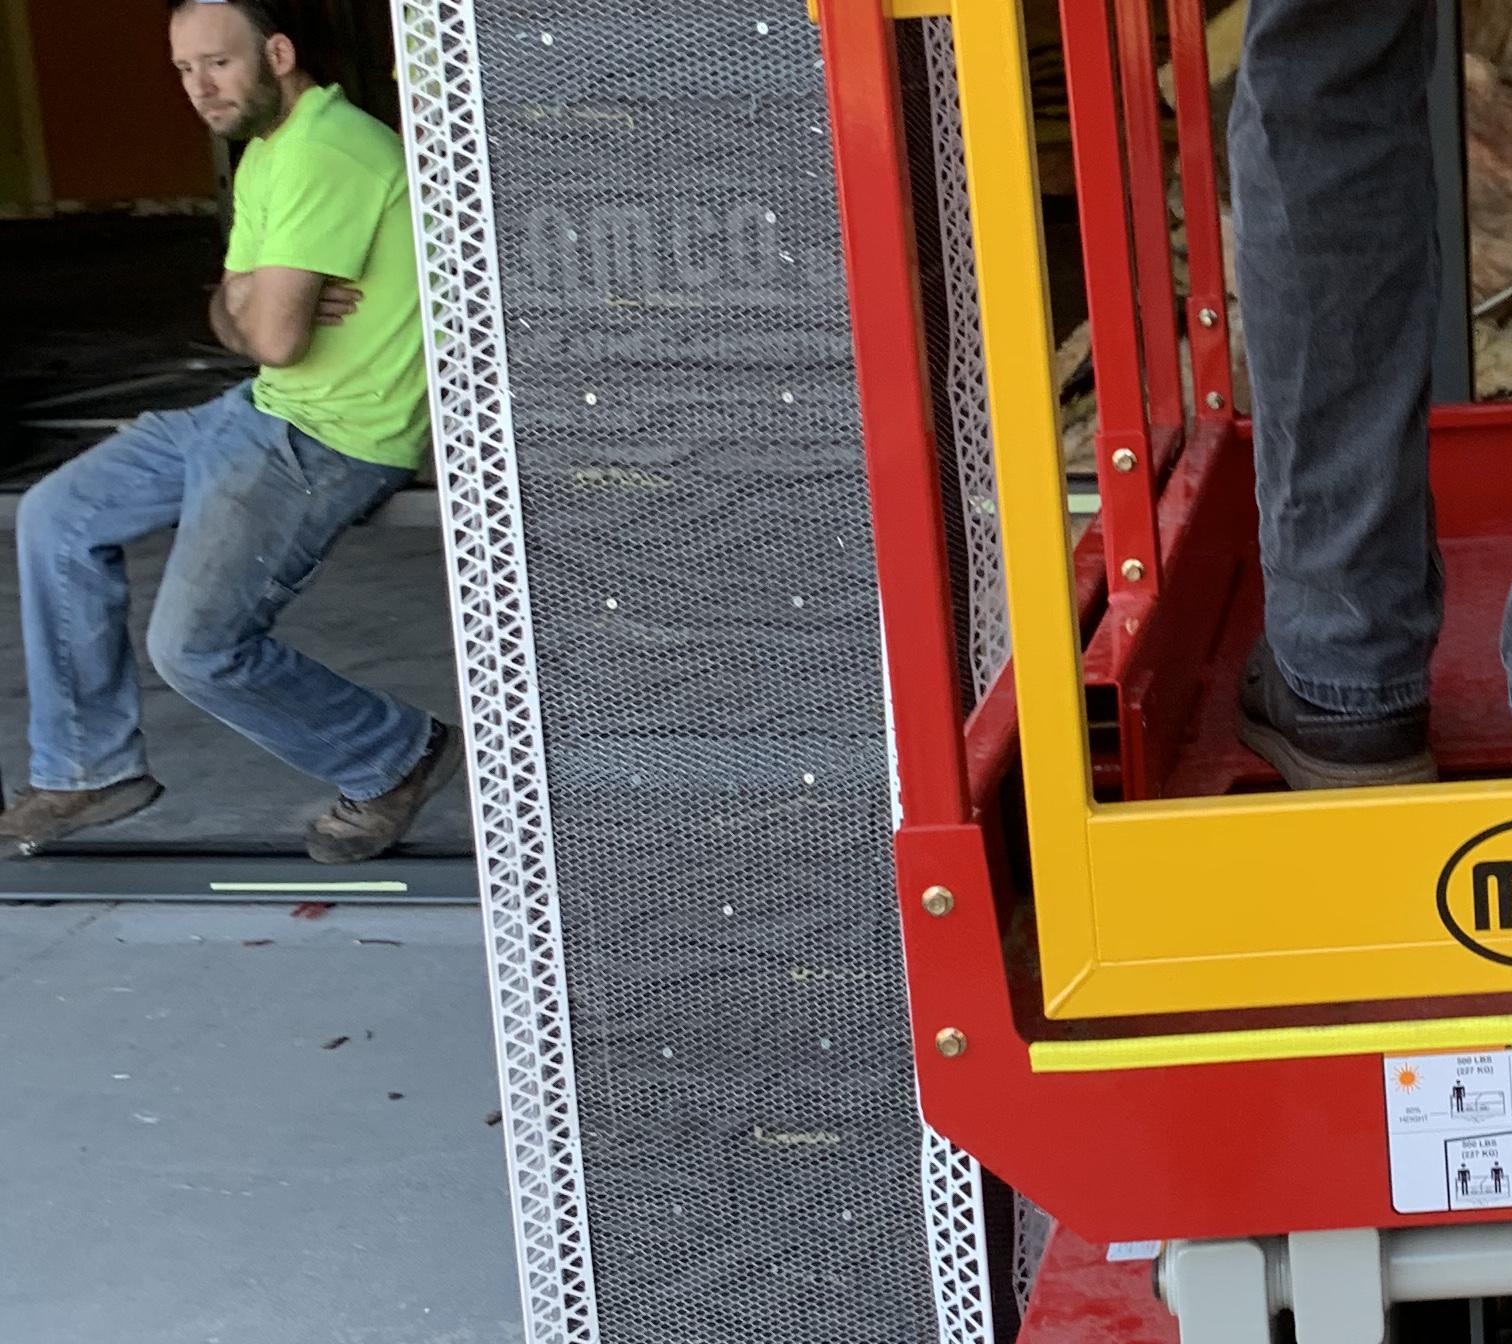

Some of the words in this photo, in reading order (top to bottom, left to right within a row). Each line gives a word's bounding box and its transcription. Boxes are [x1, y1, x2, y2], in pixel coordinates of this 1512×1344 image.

[1474, 1056, 1493, 1064] LBS
[1399, 1113, 1428, 1123] HEIGHT
[1479, 1139, 1497, 1148] LBS
